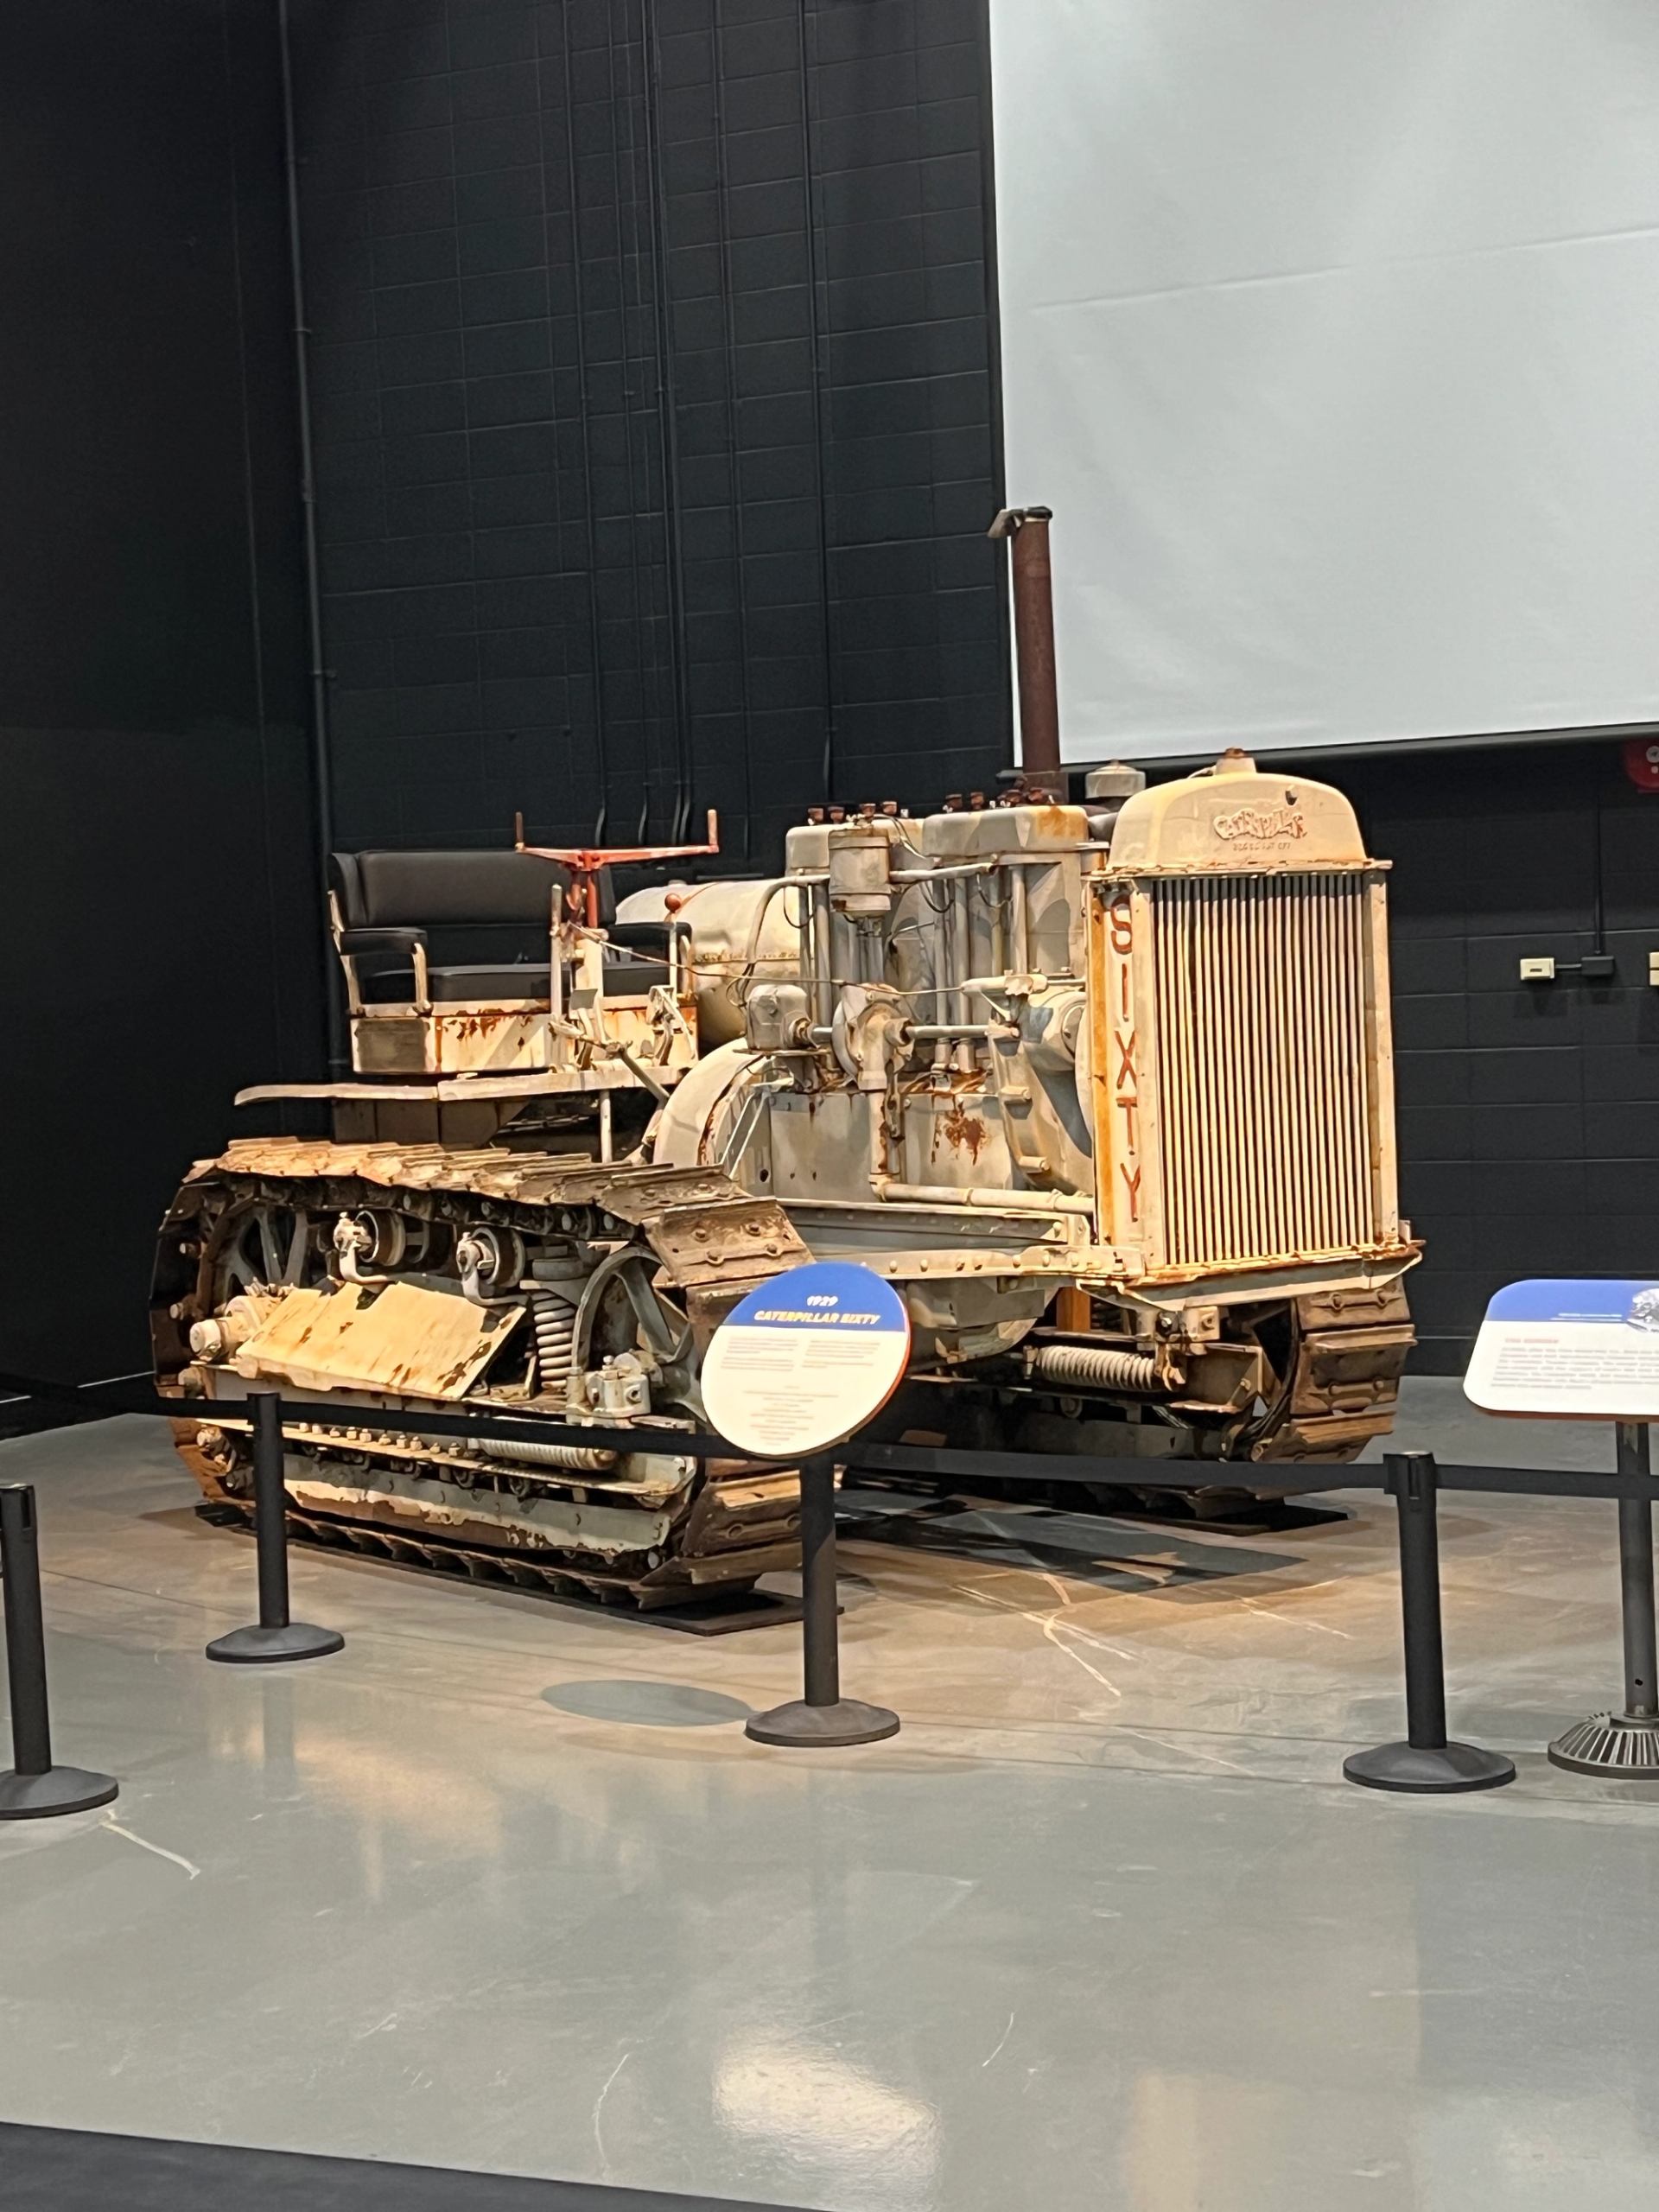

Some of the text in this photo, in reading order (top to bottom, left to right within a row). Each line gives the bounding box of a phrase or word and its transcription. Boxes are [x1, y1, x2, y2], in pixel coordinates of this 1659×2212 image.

[1110, 894, 1141, 1222] SIXTY
[753, 1310, 880, 1325] CATERPILLAR SIXTY
